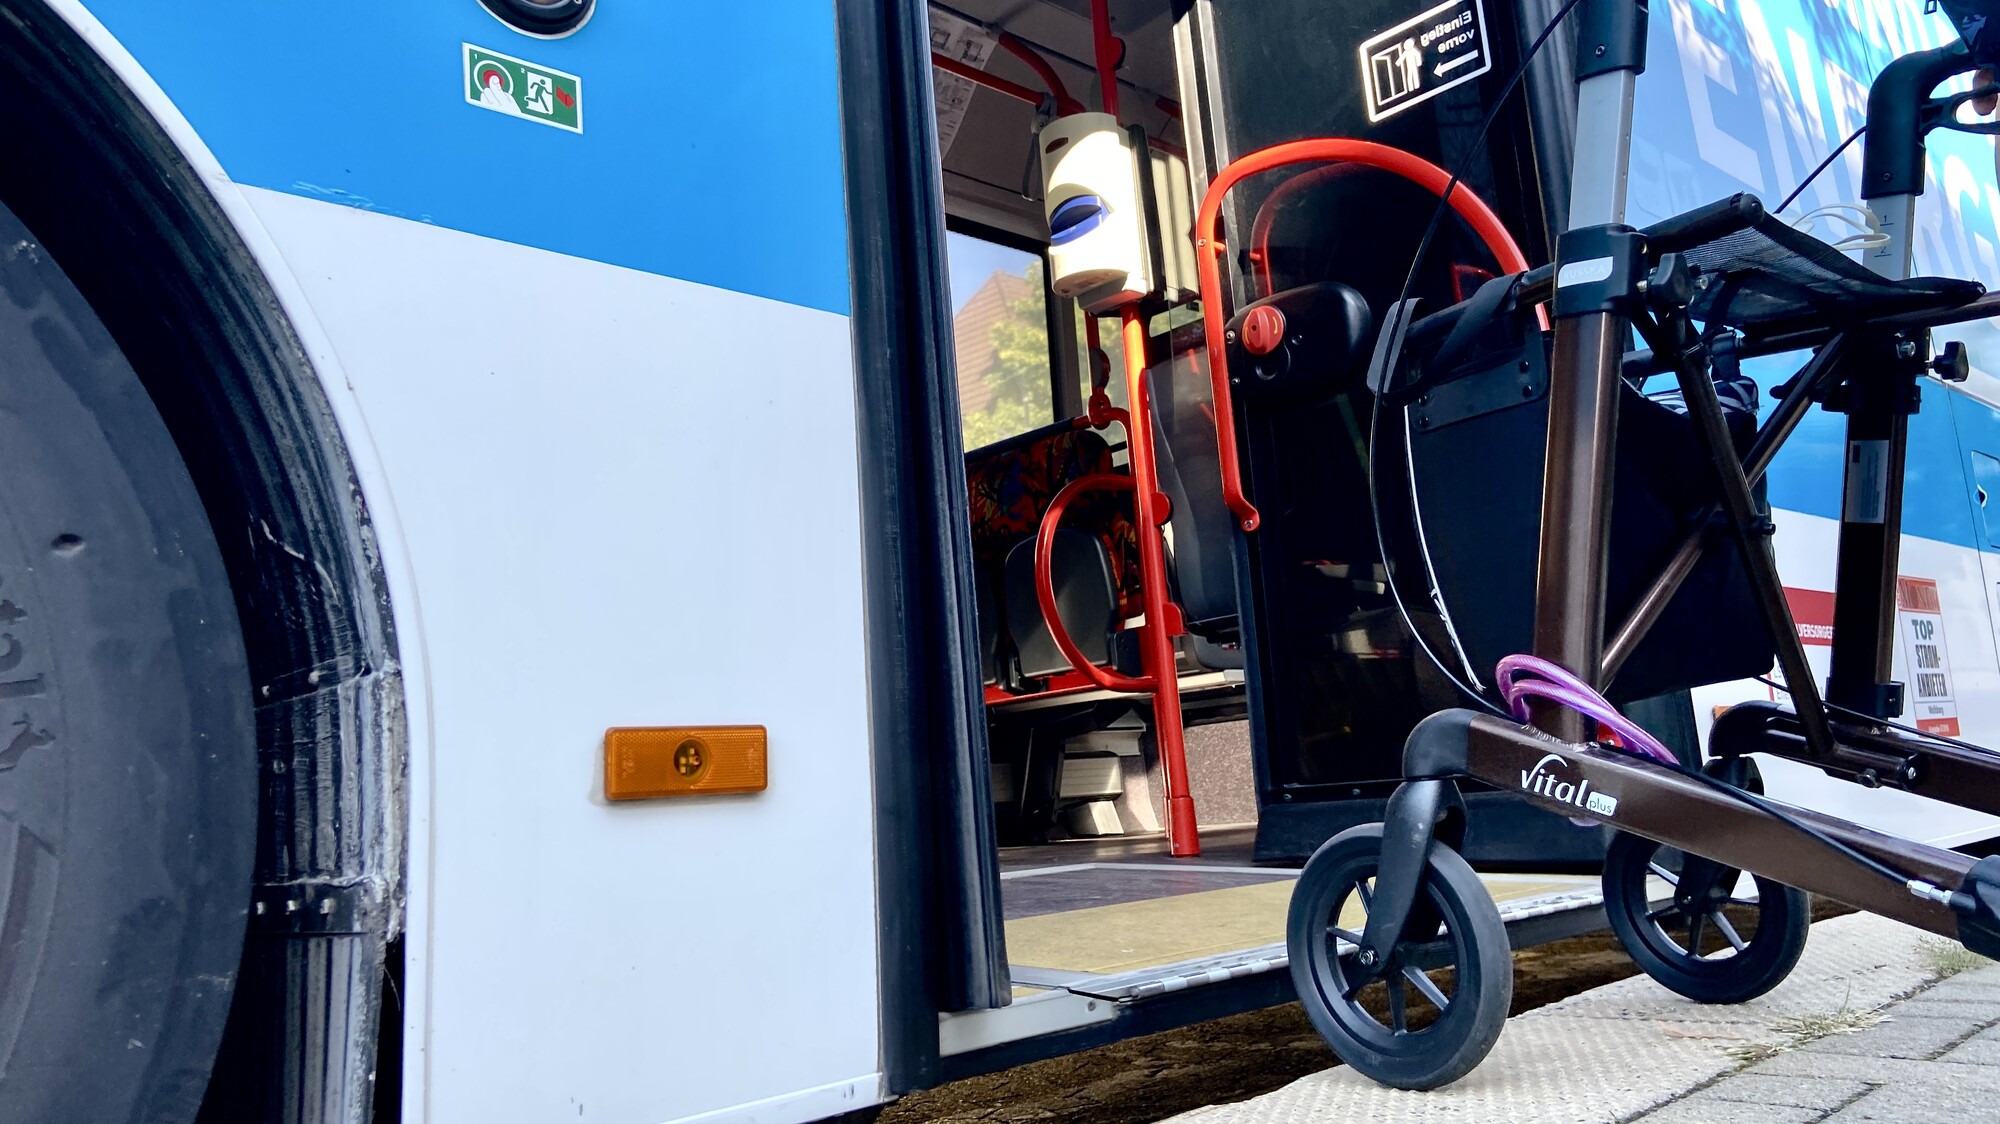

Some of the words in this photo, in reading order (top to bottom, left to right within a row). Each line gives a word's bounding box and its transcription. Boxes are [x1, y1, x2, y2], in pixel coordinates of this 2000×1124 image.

[1911, 619, 1934, 641] TOP
[1915, 644, 1941, 669] STROM-
[1916, 673, 1948, 697] ANBIETER
[1588, 797, 1613, 814] plus
